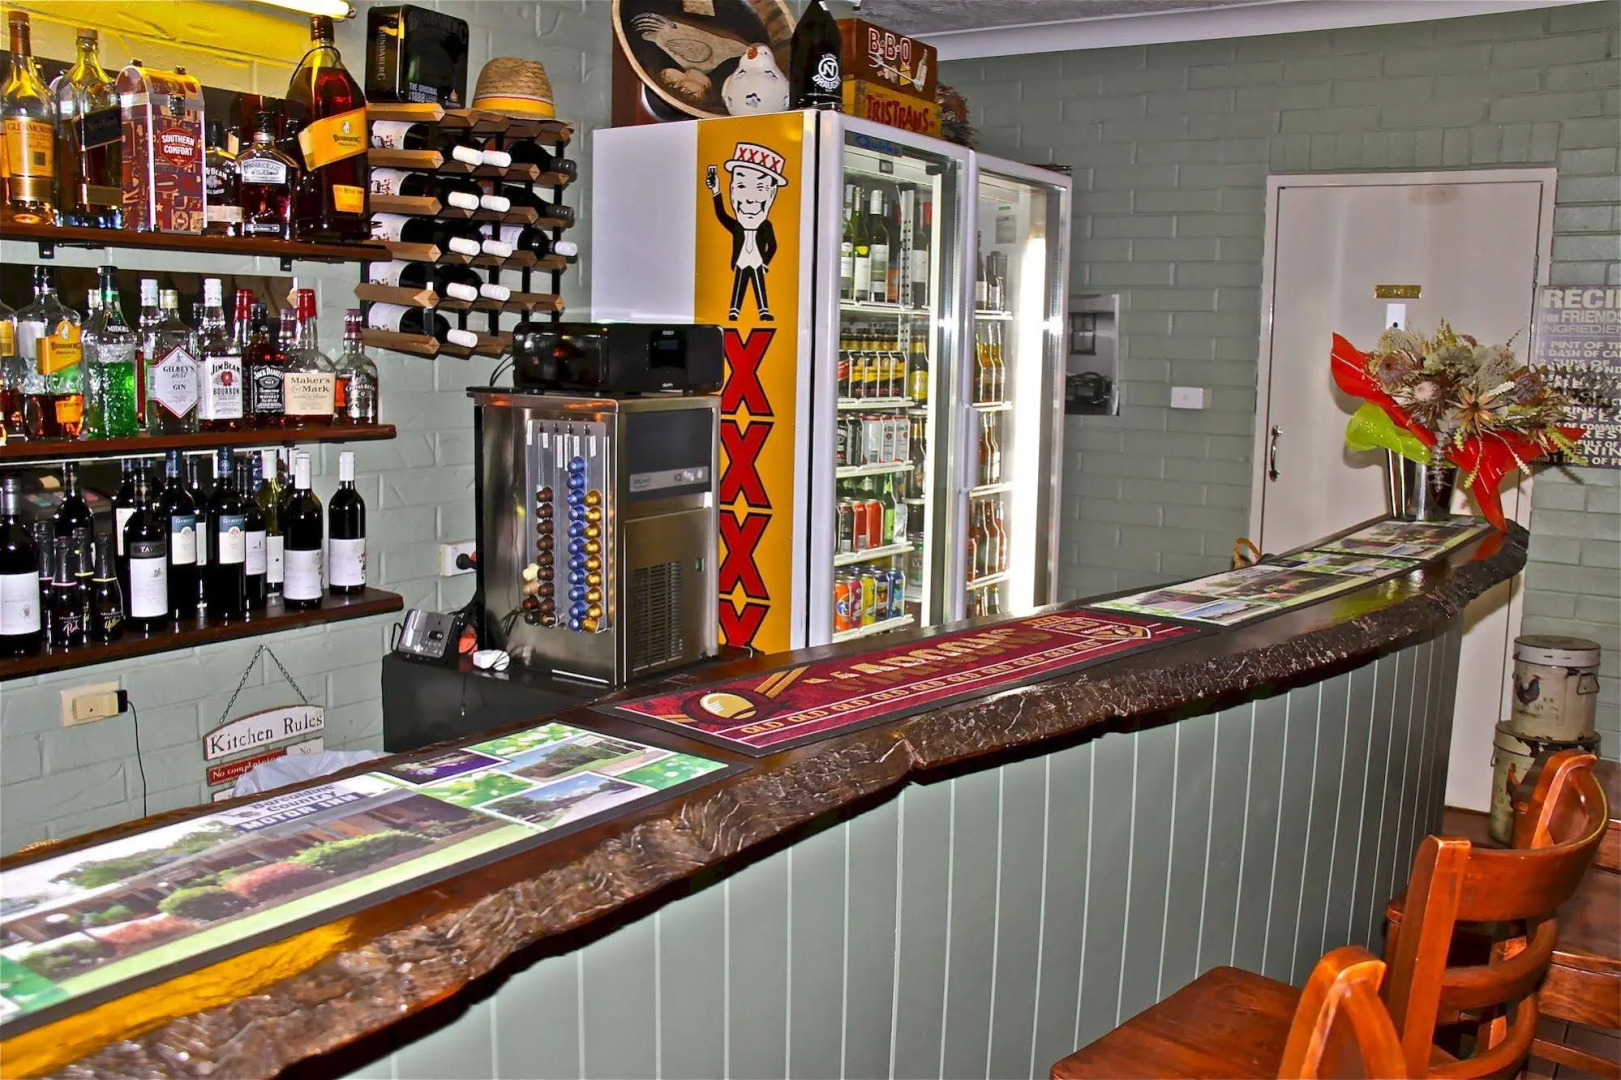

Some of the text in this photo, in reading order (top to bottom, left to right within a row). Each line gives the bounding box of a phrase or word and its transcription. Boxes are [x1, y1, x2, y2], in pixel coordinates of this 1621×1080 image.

[161, 134, 195, 147] SOUTHERN
[163, 145, 194, 157] COMFORT
[739, 147, 781, 174] XXXX
[1583, 341, 1605, 350] OF
[1583, 350, 1600, 358] OF
[163, 366, 195, 374] GILBEY'S
[211, 361, 240, 376] JIM BEAM
[290, 376, 331, 384] Maker's
[213, 387, 240, 396] BOURBON
[301, 385, 331, 393] Mark
[210, 712, 323, 754] Kitchen Rules
[300, 746, 312, 755] No
[212, 768, 225, 779] No
[267, 791, 336, 812] Country
[240, 793, 360, 830] MOTOR INN
